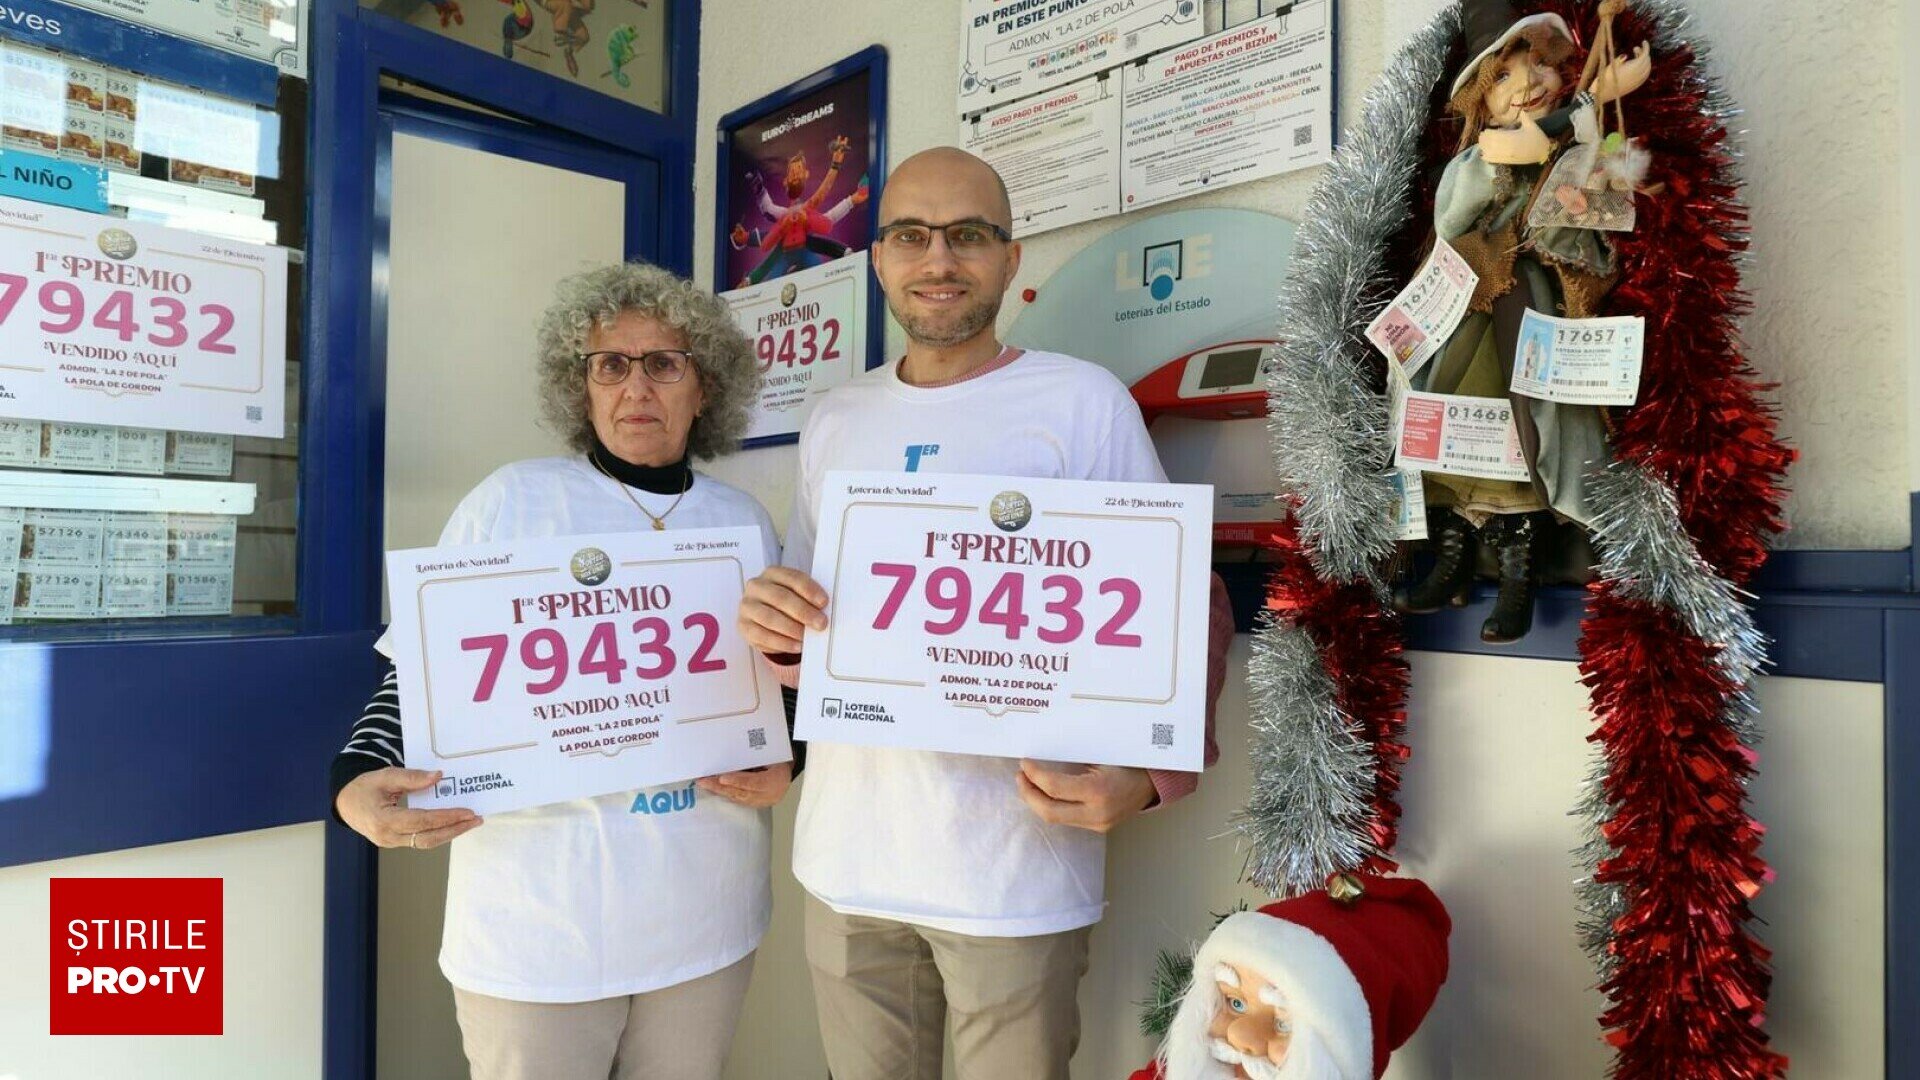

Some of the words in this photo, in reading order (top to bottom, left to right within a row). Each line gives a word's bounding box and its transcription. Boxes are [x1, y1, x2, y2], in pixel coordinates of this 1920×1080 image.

[974, 14, 989, 28] EN
[997, 21, 1013, 34] EN
[1017, 9, 1045, 28] ESTE
[1076, 18, 1082, 29] 2
[1085, 10, 1100, 25] DE
[1165, 67, 1176, 77] DE
[1178, 51, 1224, 72] APUESTAS
[1226, 46, 1242, 56] con
[1245, 33, 1277, 50] BIZUM
[1174, 48, 1199, 62] PAGO
[1201, 43, 1213, 54] DE
[1216, 28, 1260, 49] PREMIOS
[991, 115, 1012, 127] AVISO
[1013, 108, 1031, 120] PAGO
[1034, 104, 1043, 114] DE
[1044, 93, 1078, 109] PREMIOS
[761, 124, 785, 143] EURO
[794, 102, 835, 128] DREAMS
[1194, 119, 1233, 136] IMPORTANTE
[14, 166, 72, 190] NIÑO
[61, 255, 192, 294] PREMIO
[0, 272, 236, 354] 79432
[1156, 302, 1172, 315] del
[1175, 296, 1211, 312] Estado
[767, 302, 820, 330] PREMIO
[1559, 329, 1615, 343] 17657
[44, 341, 128, 361] VENDIDO
[133, 352, 177, 369] AQUÍ
[59, 364, 99, 373] ADMON.
[80, 378, 105, 387] POLA
[1448, 406, 1510, 421] 01468
[882, 486, 894, 495] de
[1105, 497, 1116, 507] 22
[1118, 498, 1130, 507] de
[1131, 498, 1184, 509] Diciembre
[674, 543, 684, 551] 22
[685, 543, 695, 551] de
[696, 541, 740, 551] Diciembre
[951, 532, 1091, 568] PREMIO
[456, 560, 469, 569] de
[538, 584, 672, 620] PREMIO
[870, 562, 1142, 649] 79432
[460, 612, 727, 702] 79432
[927, 646, 1013, 668] VENDIDO
[1018, 652, 1069, 675] AQUÍ
[940, 675, 981, 686] ADMON.
[1003, 680, 1009, 688] 2
[1011, 681, 1024, 689] DE
[533, 696, 619, 720] VENDIDO
[625, 685, 670, 709] AQUÍ
[845, 702, 885, 713] LOTERÍA
[945, 692, 958, 701] LA
[960, 693, 987, 703] POLA
[989, 696, 1003, 704] DE
[1004, 697, 1049, 708] GORDON
[844, 712, 895, 723] NACIONAL
[552, 725, 594, 738] ADMON.
[614, 720, 620, 729] 2
[621, 718, 633, 728] DE
[560, 744, 572, 753] LA
[574, 740, 601, 751] POLA
[603, 737, 616, 746] DE
[617, 731, 660, 744] GORDON
[460, 772, 502, 786] LOTERÍA
[460, 780, 514, 794] NACIONAL
[630, 780, 697, 815] AQUÍ
